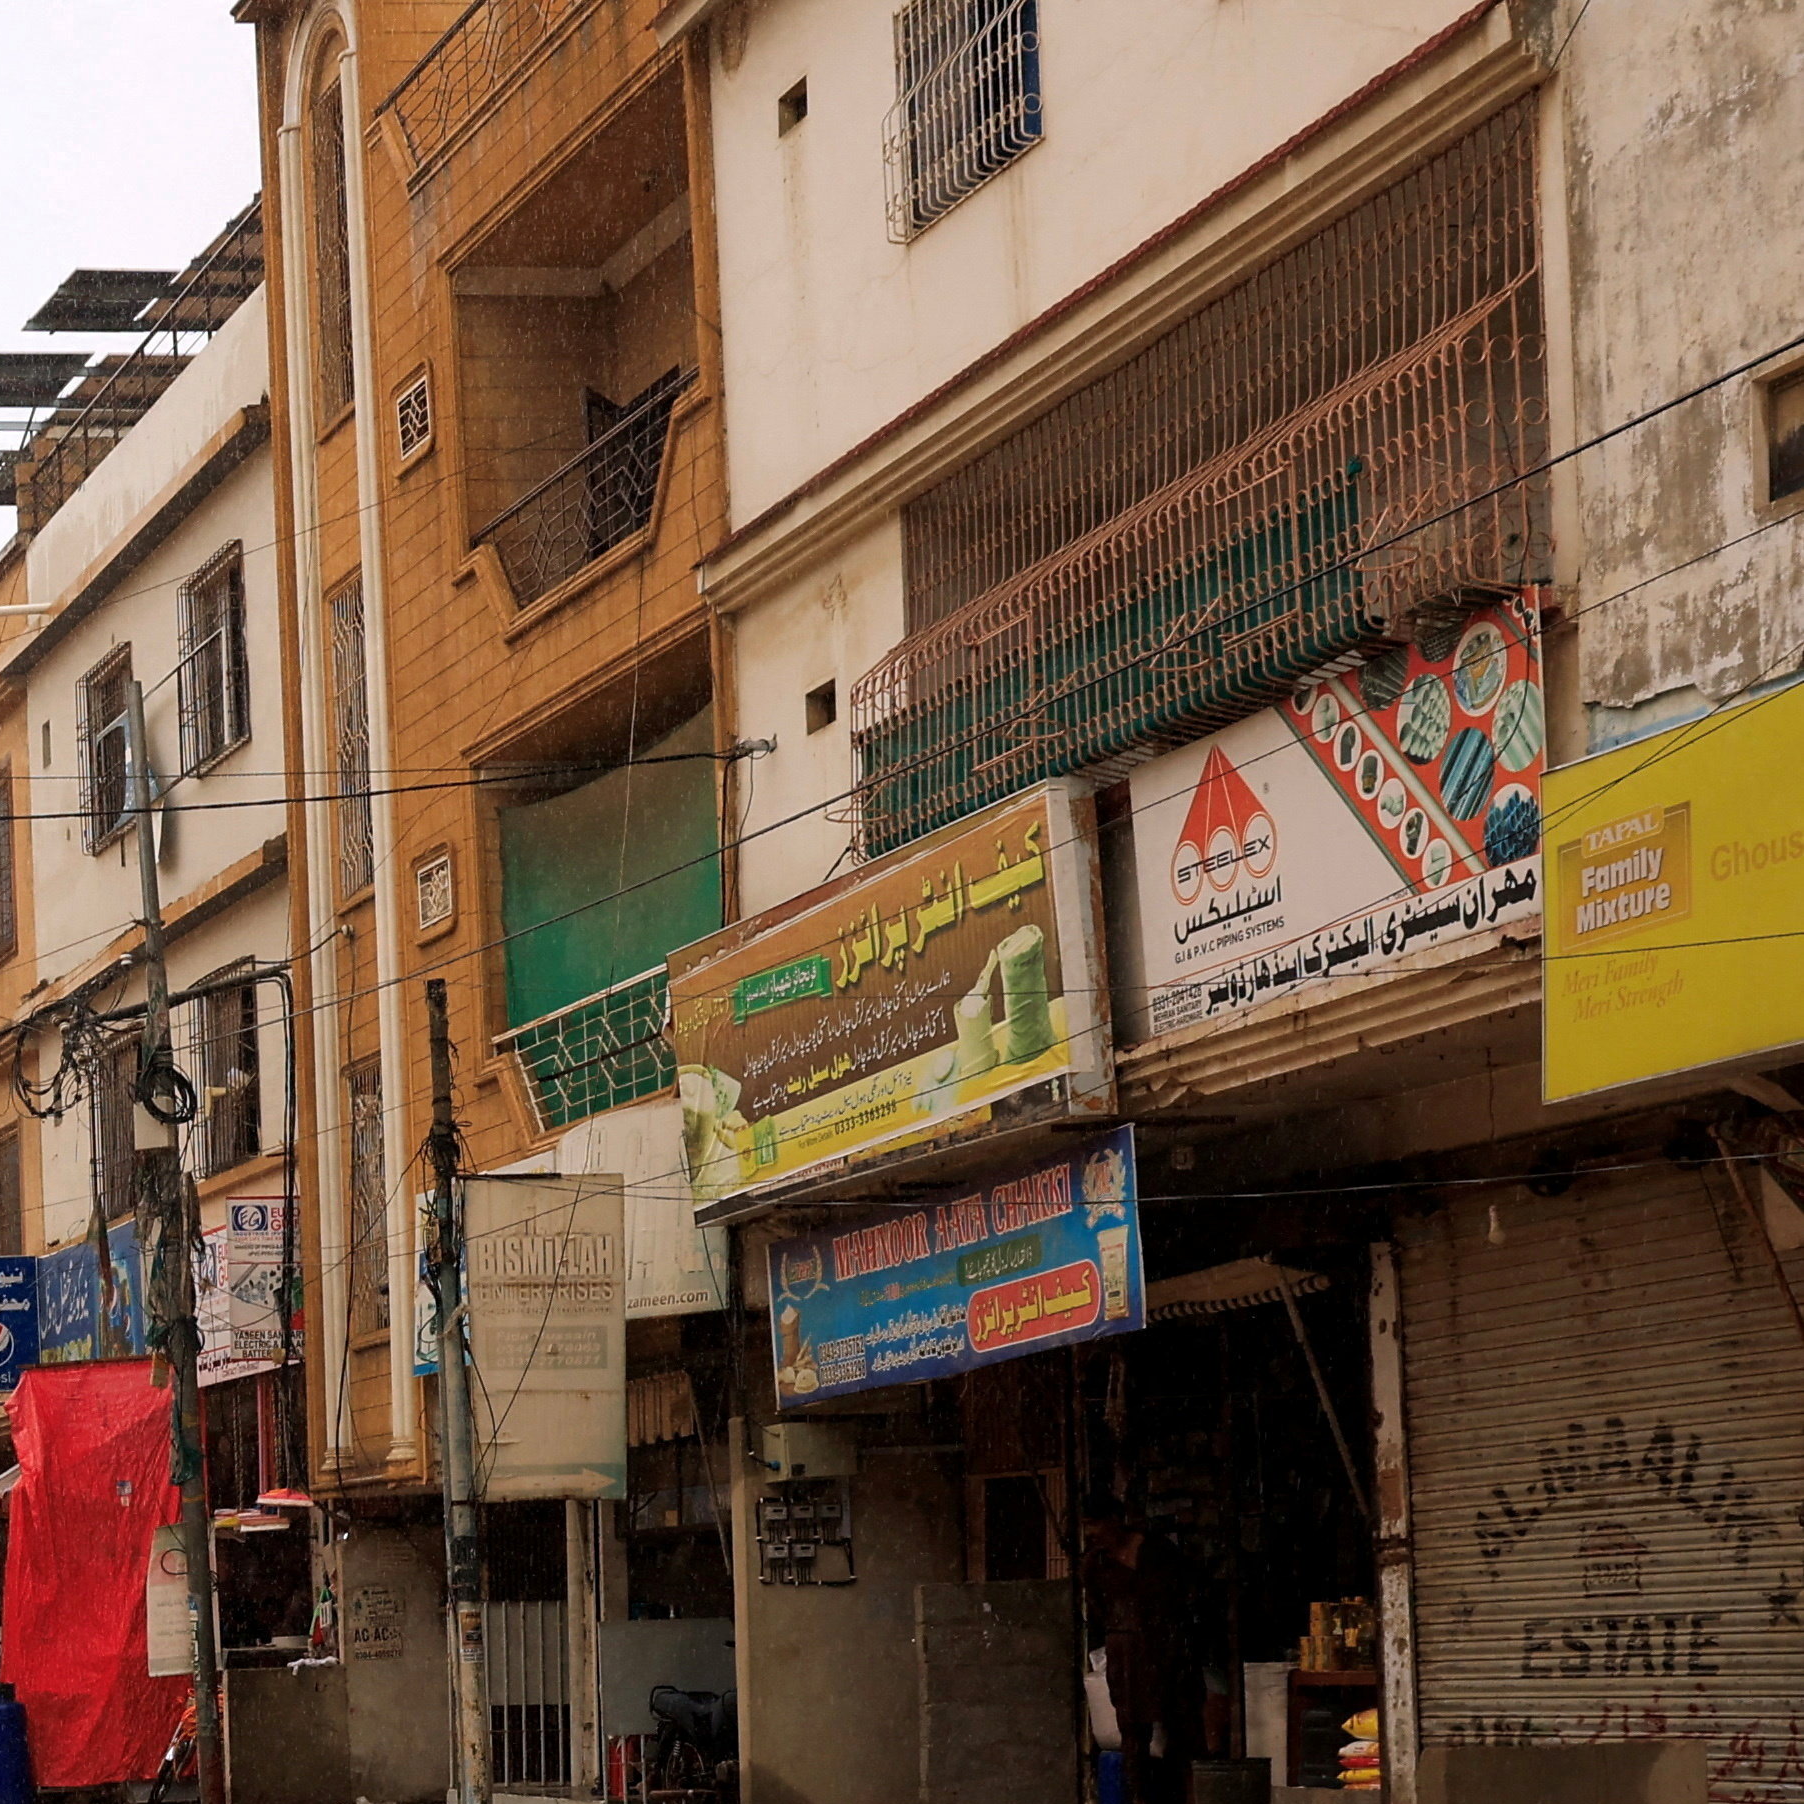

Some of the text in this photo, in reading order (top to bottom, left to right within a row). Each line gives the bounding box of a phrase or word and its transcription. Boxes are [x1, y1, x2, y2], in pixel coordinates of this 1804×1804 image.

[1586, 813, 1656, 850] TAPAL
[1177, 834, 1271, 884] STEELEX
[1581, 847, 1664, 897] Family
[1174, 877, 1281, 944] اسٹیلیکس
[1577, 882, 1671, 935] Mixture
[1187, 949, 1193, 960] &
[1194, 941, 1216, 958] P.V.C
[1217, 932, 1244, 951] PIPING
[1245, 917, 1285, 941] SYSTEMS
[1564, 951, 1659, 996] Meri Family
[1574, 969, 1684, 1023] Meri Strength
[833, 1211, 930, 1281] MAHNOOR
[935, 1193, 988, 1254] AATA
[993, 1163, 1072, 1234] CHAKKI
[476, 1232, 614, 1276] BISMILLAH
[627, 1290, 709, 1310] zameen.com
[1521, 1613, 1721, 1678] ESTATE
